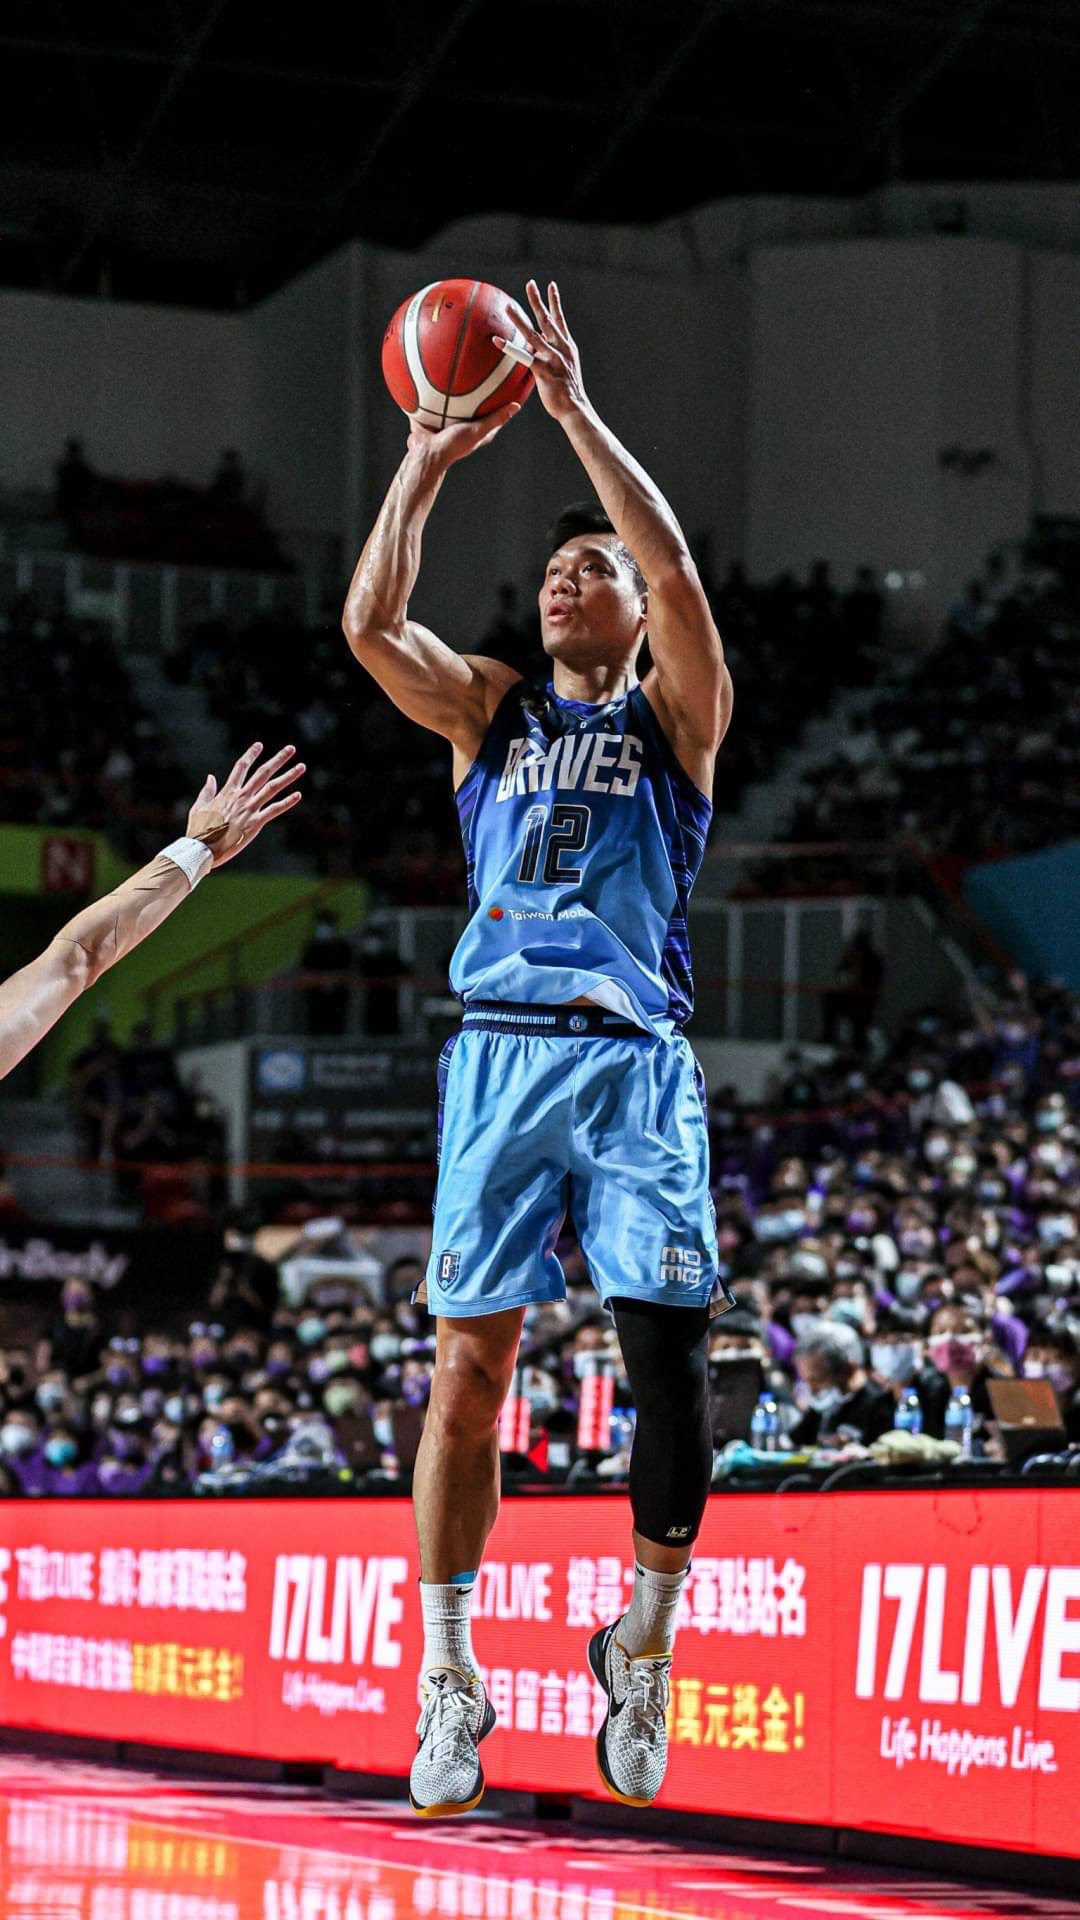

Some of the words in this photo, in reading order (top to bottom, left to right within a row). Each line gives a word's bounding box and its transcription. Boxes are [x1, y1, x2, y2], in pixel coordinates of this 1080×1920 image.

[496, 733, 643, 803] BRAVES
[517, 803, 592, 886] 12
[508, 909, 554, 921] Taiwan
[268, 1554, 408, 1668] 17LIVE
[855, 1563, 1080, 1712] 17LIVE
[880, 1715, 918, 1770] Life
[919, 1718, 1008, 1777] Happens
